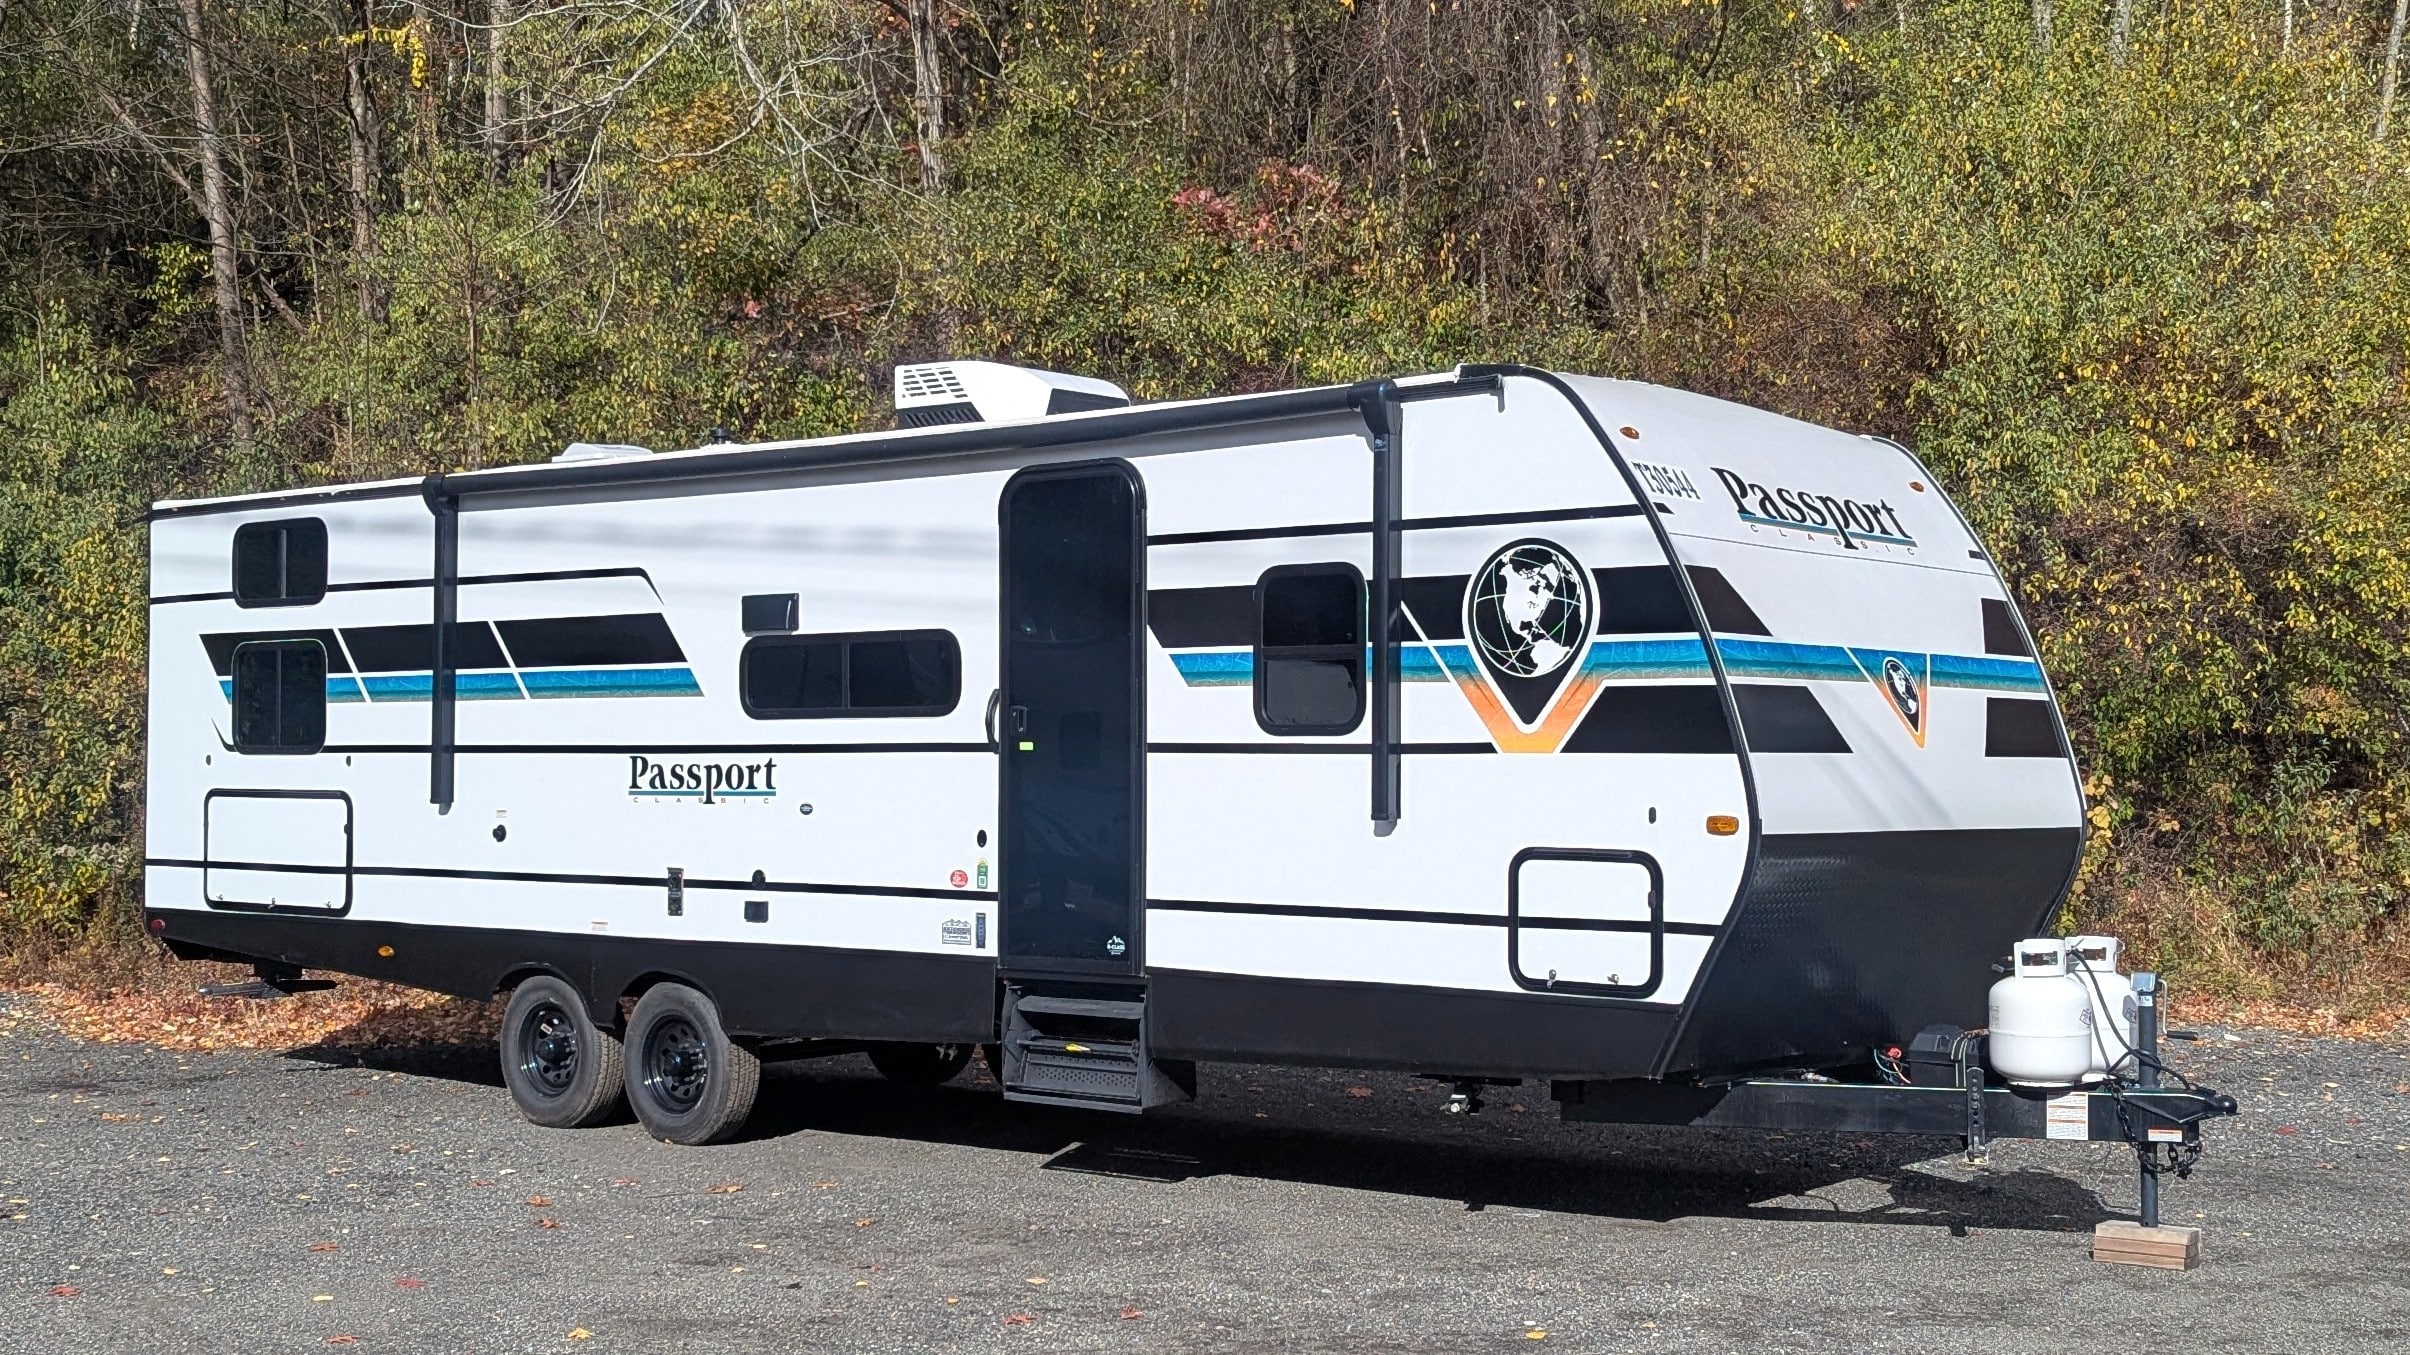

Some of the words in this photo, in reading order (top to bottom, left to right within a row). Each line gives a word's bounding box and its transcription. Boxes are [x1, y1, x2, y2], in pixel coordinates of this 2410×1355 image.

[1631, 461, 1701, 500] T30544
[1710, 466, 1913, 550] Passport
[1750, 524, 1916, 556] CLASSIC
[629, 755, 777, 804] Passport
[633, 796, 770, 804] CLASSIC
